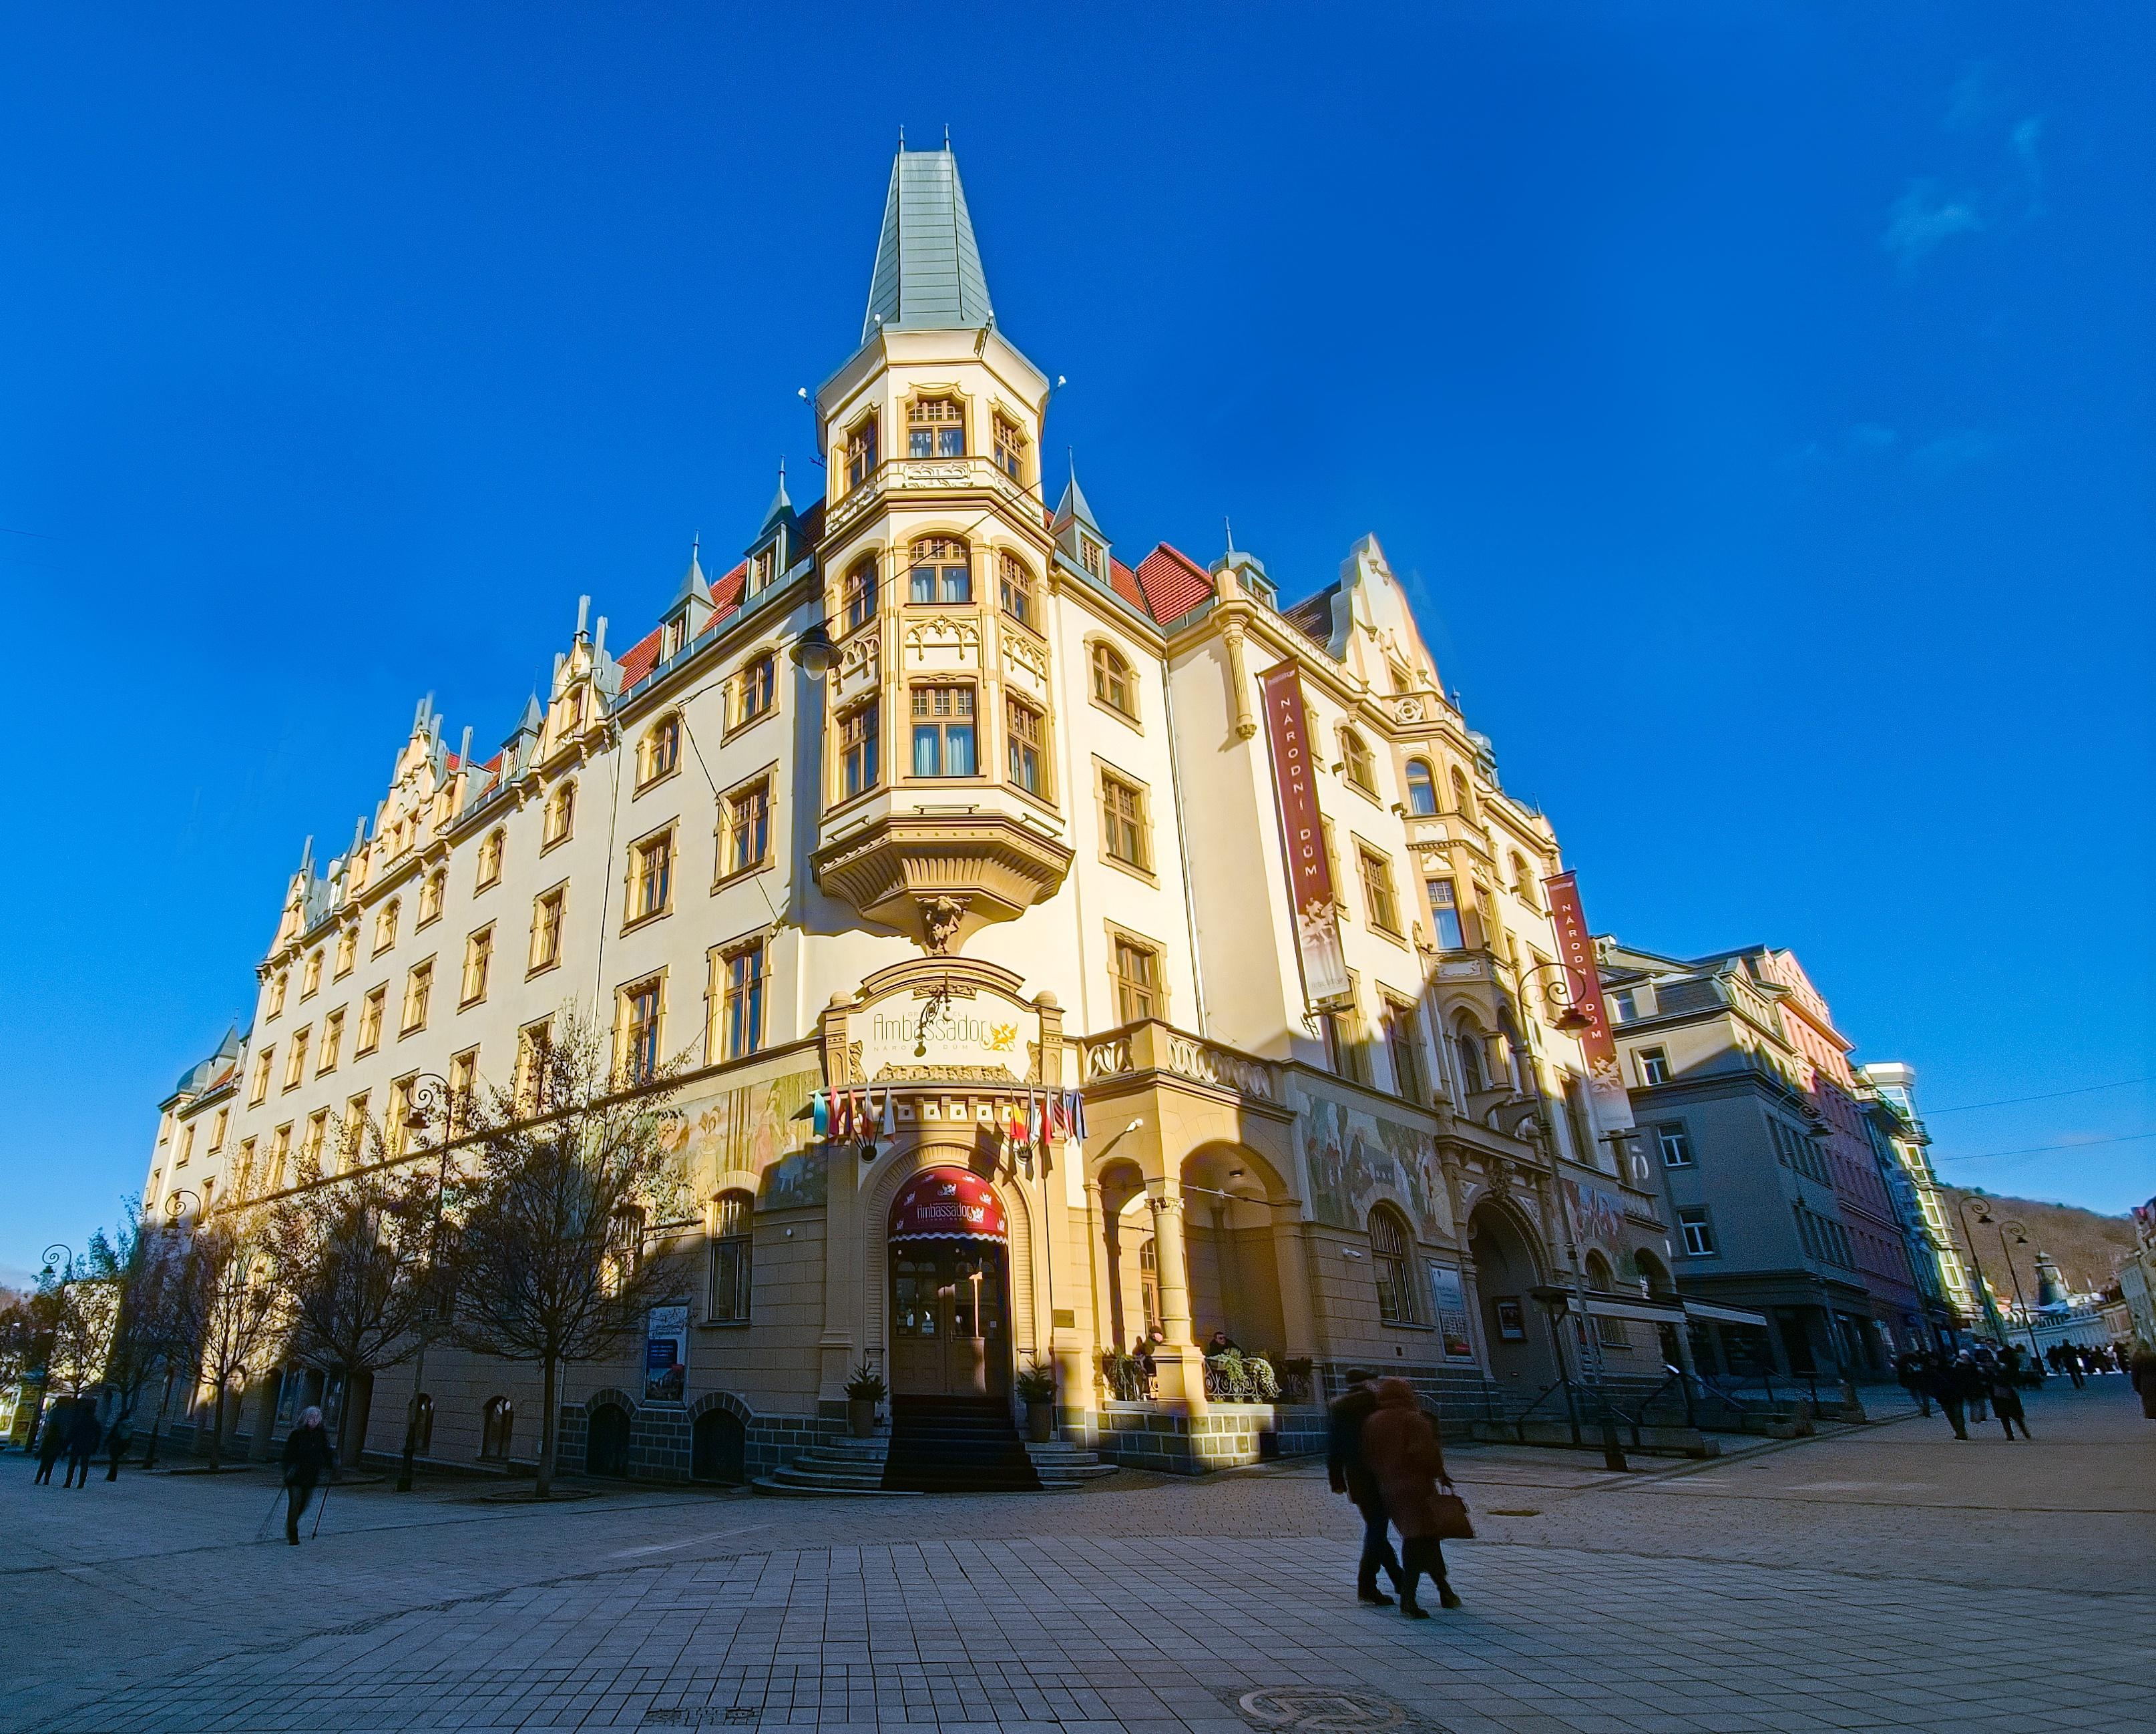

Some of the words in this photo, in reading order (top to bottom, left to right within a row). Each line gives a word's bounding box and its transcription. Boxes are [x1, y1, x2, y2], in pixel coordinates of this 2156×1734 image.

[1300, 829, 1317, 876] DŮM
[1562, 904, 1587, 976] NÁRODN
[874, 1013, 986, 1042] Ambassador
[917, 1203, 970, 1219] Ambassador
